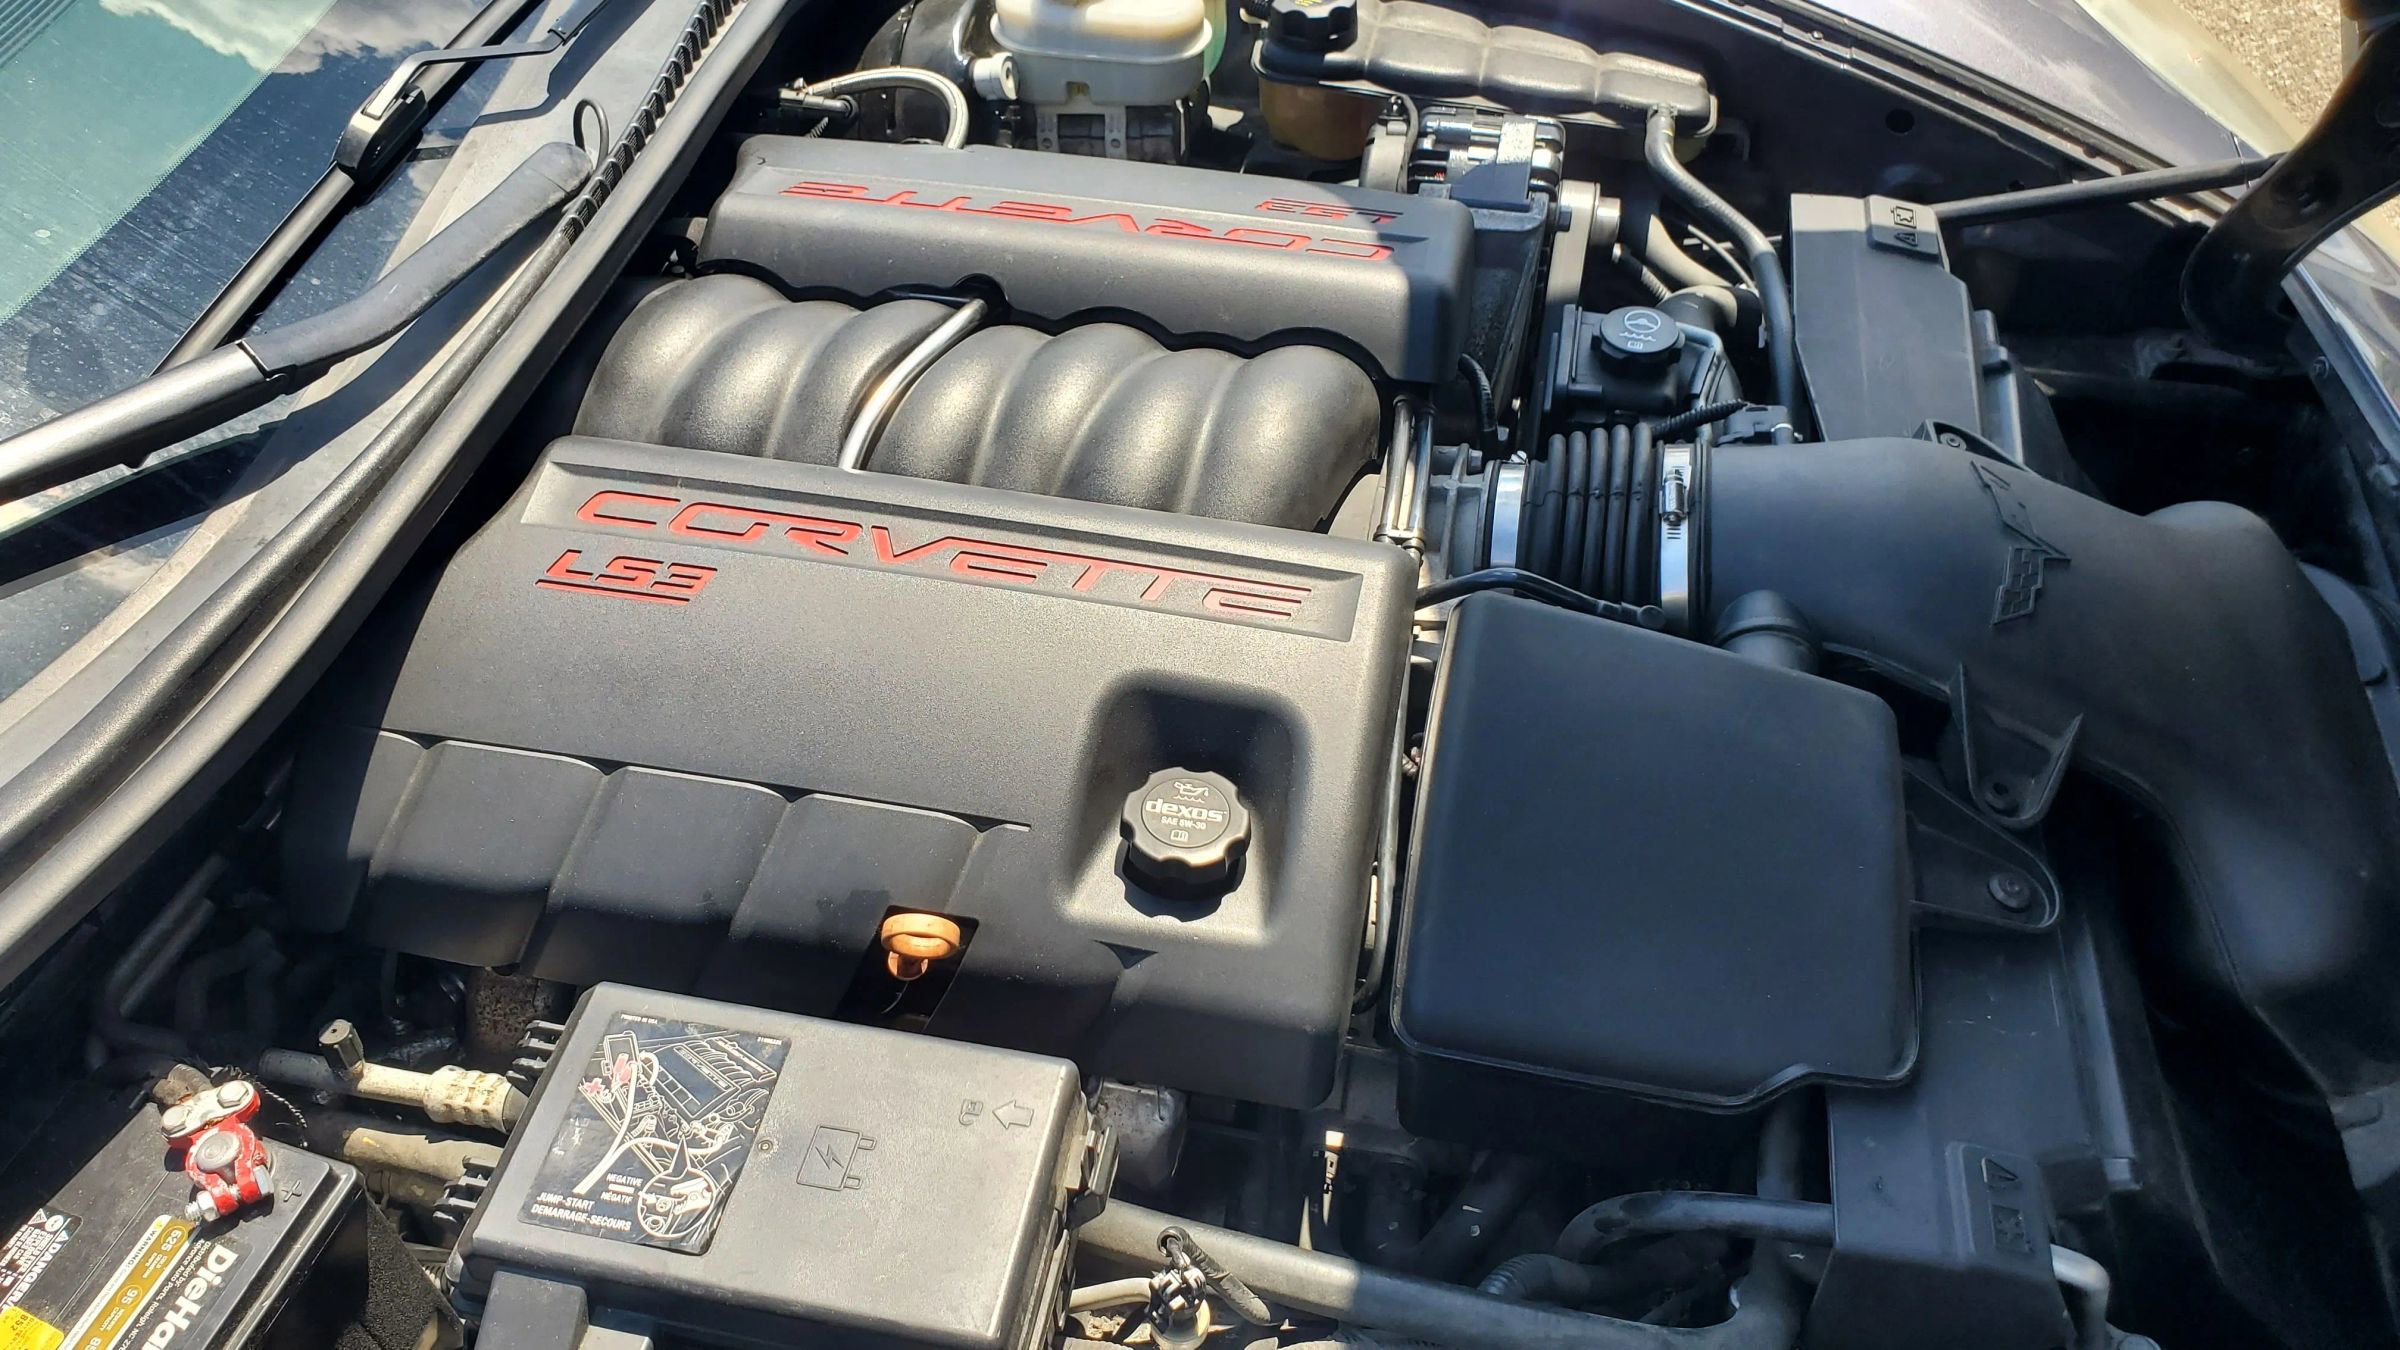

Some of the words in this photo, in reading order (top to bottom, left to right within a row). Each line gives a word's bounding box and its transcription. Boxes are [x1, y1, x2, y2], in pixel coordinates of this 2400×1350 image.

[779, 181, 1395, 261] CORVETTE
[1255, 198, 1403, 223] LS3
[576, 490, 1312, 620] CORVETTE
[544, 549, 718, 596] LS3
[1145, 799, 1223, 822] dexos
[1161, 815, 1179, 827] SAE
[1179, 817, 1207, 830] 5W-30
[607, 1173, 643, 1186] NEGATIVE
[536, 1192, 595, 1210] JUMP-START
[530, 1203, 632, 1231] DEMARRAGE-SECOURS
[161, 1229, 182, 1251] 525
[183, 1238, 205, 1266] Advance
[182, 1241, 212, 1279] Distributed
[1, 1242, 62, 1313] DANGER/
[170, 1265, 185, 1282] Auto
[121, 1288, 138, 1305] 95
[128, 1328, 140, 1340] NC
